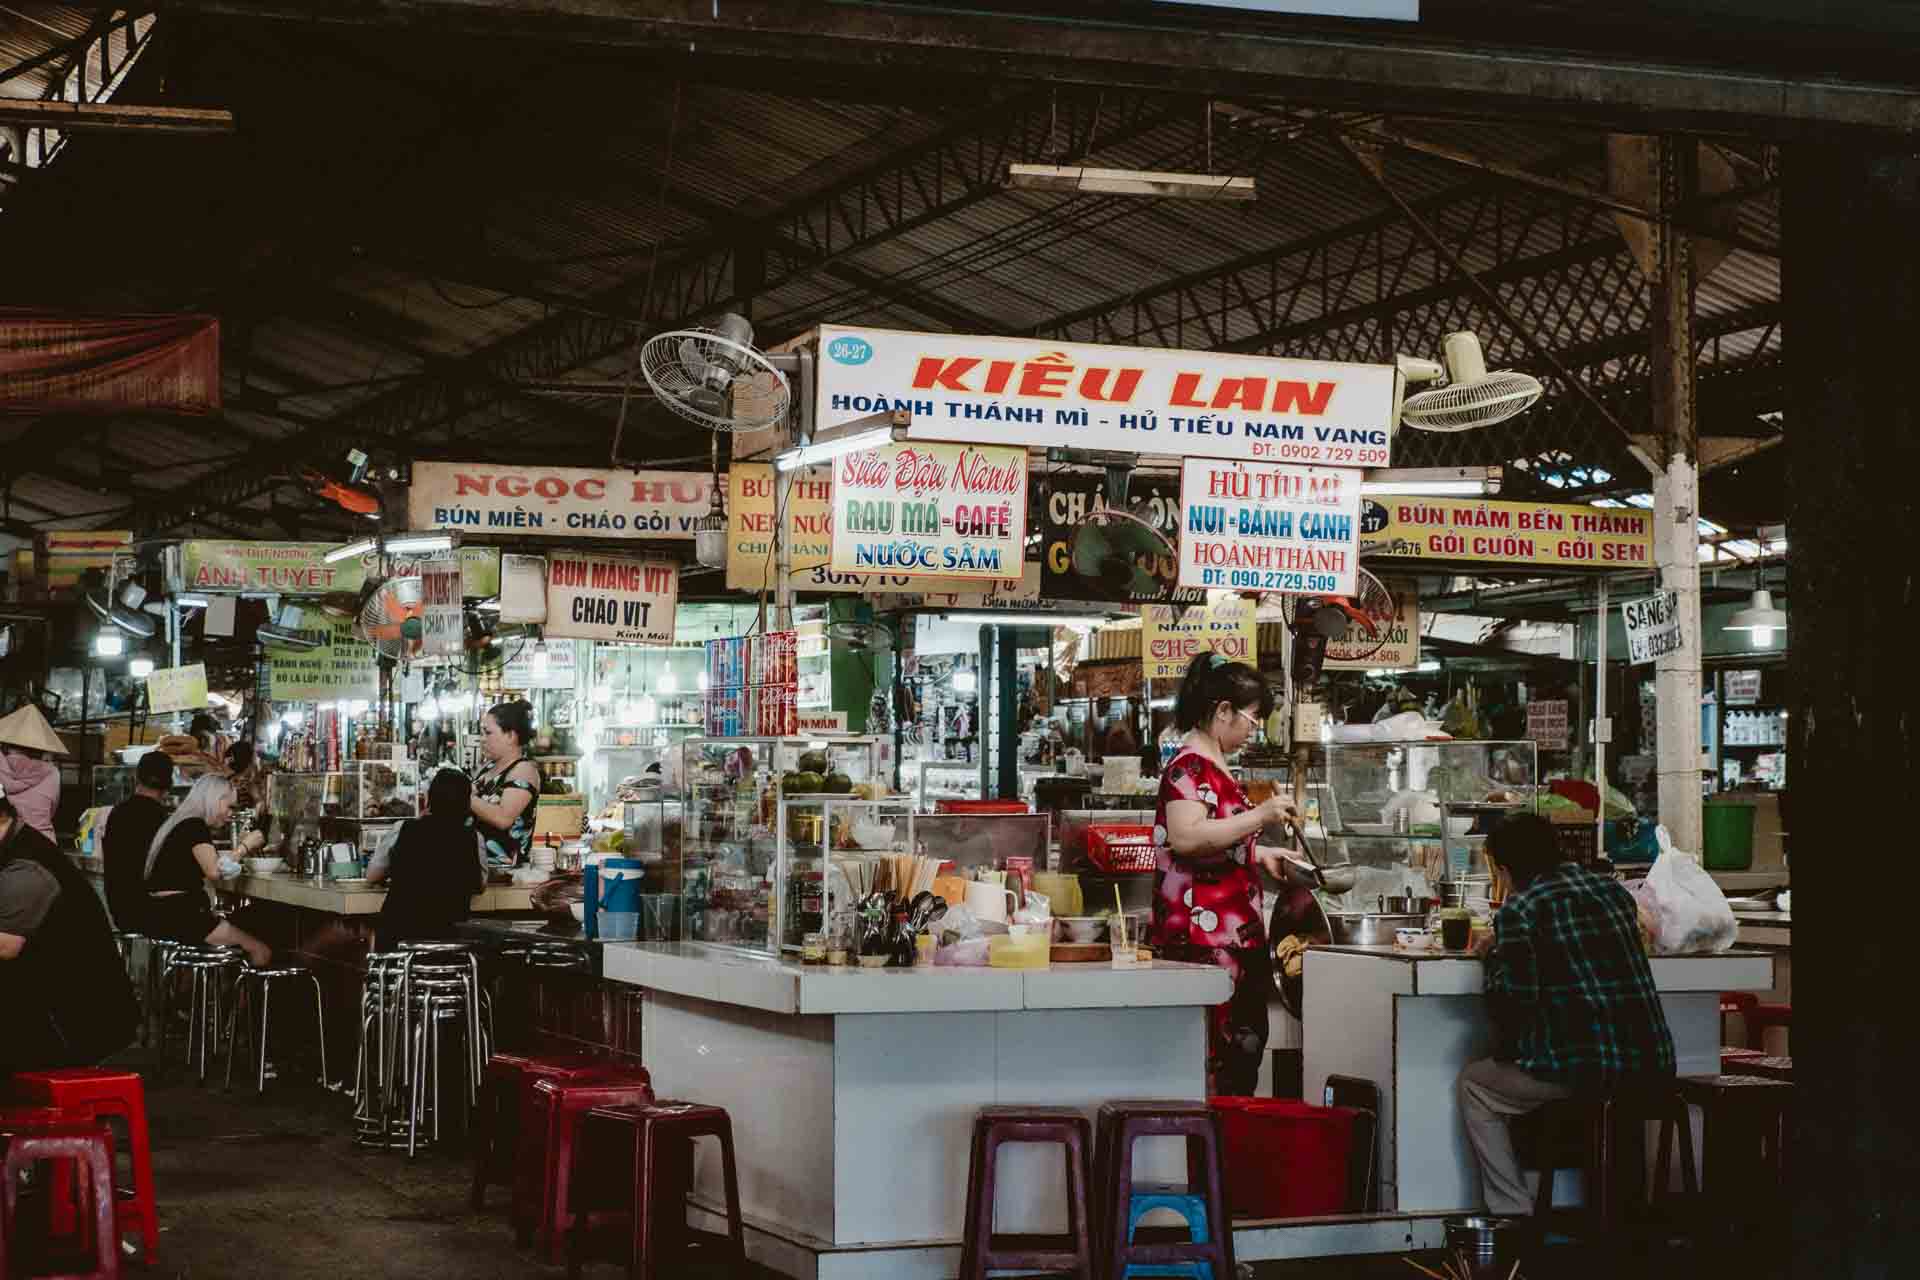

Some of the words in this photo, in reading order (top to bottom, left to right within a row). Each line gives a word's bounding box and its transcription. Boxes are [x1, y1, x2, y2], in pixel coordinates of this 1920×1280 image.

[833, 343, 867, 360] 26-27
[911, 351, 1145, 403] KIỀU
[1167, 371, 1337, 416] LAN
[831, 393, 934, 416] HOÀNH
[944, 401, 1044, 425] THÁNH
[1055, 408, 1089, 427] MÌ
[1119, 409, 1158, 431] HỦ
[1168, 414, 1234, 436] TIẾU
[1244, 422, 1305, 441] NAM
[1314, 427, 1388, 446] VANG
[1280, 445, 1321, 460] 0902
[1326, 447, 1354, 462] 729
[1358, 449, 1388, 463] 509
[842, 449, 891, 488] Sữa
[895, 447, 947, 497] Đậu
[951, 449, 1022, 495] Nành
[453, 472, 607, 505] NGỌC
[434, 503, 481, 525] BÚN
[566, 507, 627, 531] CHÁO
[846, 499, 895, 535] RAU
[1299, 511, 1353, 544] CANH
[1397, 502, 1445, 525] BÚN
[1453, 503, 1510, 530] MẮM
[1517, 508, 1564, 531] BẾN
[1570, 511, 1645, 534] THÀNH
[855, 540, 939, 570] NƯỚC
[1192, 540, 1272, 568] HOÀNH
[1274, 543, 1346, 572] THÁNH
[1472, 532, 1535, 557] CUỐN
[1600, 540, 1645, 561] SEN
[1202, 567, 1226, 585] ĐT:
[1230, 569, 1337, 592] 090.2729.509
[572, 594, 619, 626] CHÁO
[622, 600, 652, 631] VỊT
